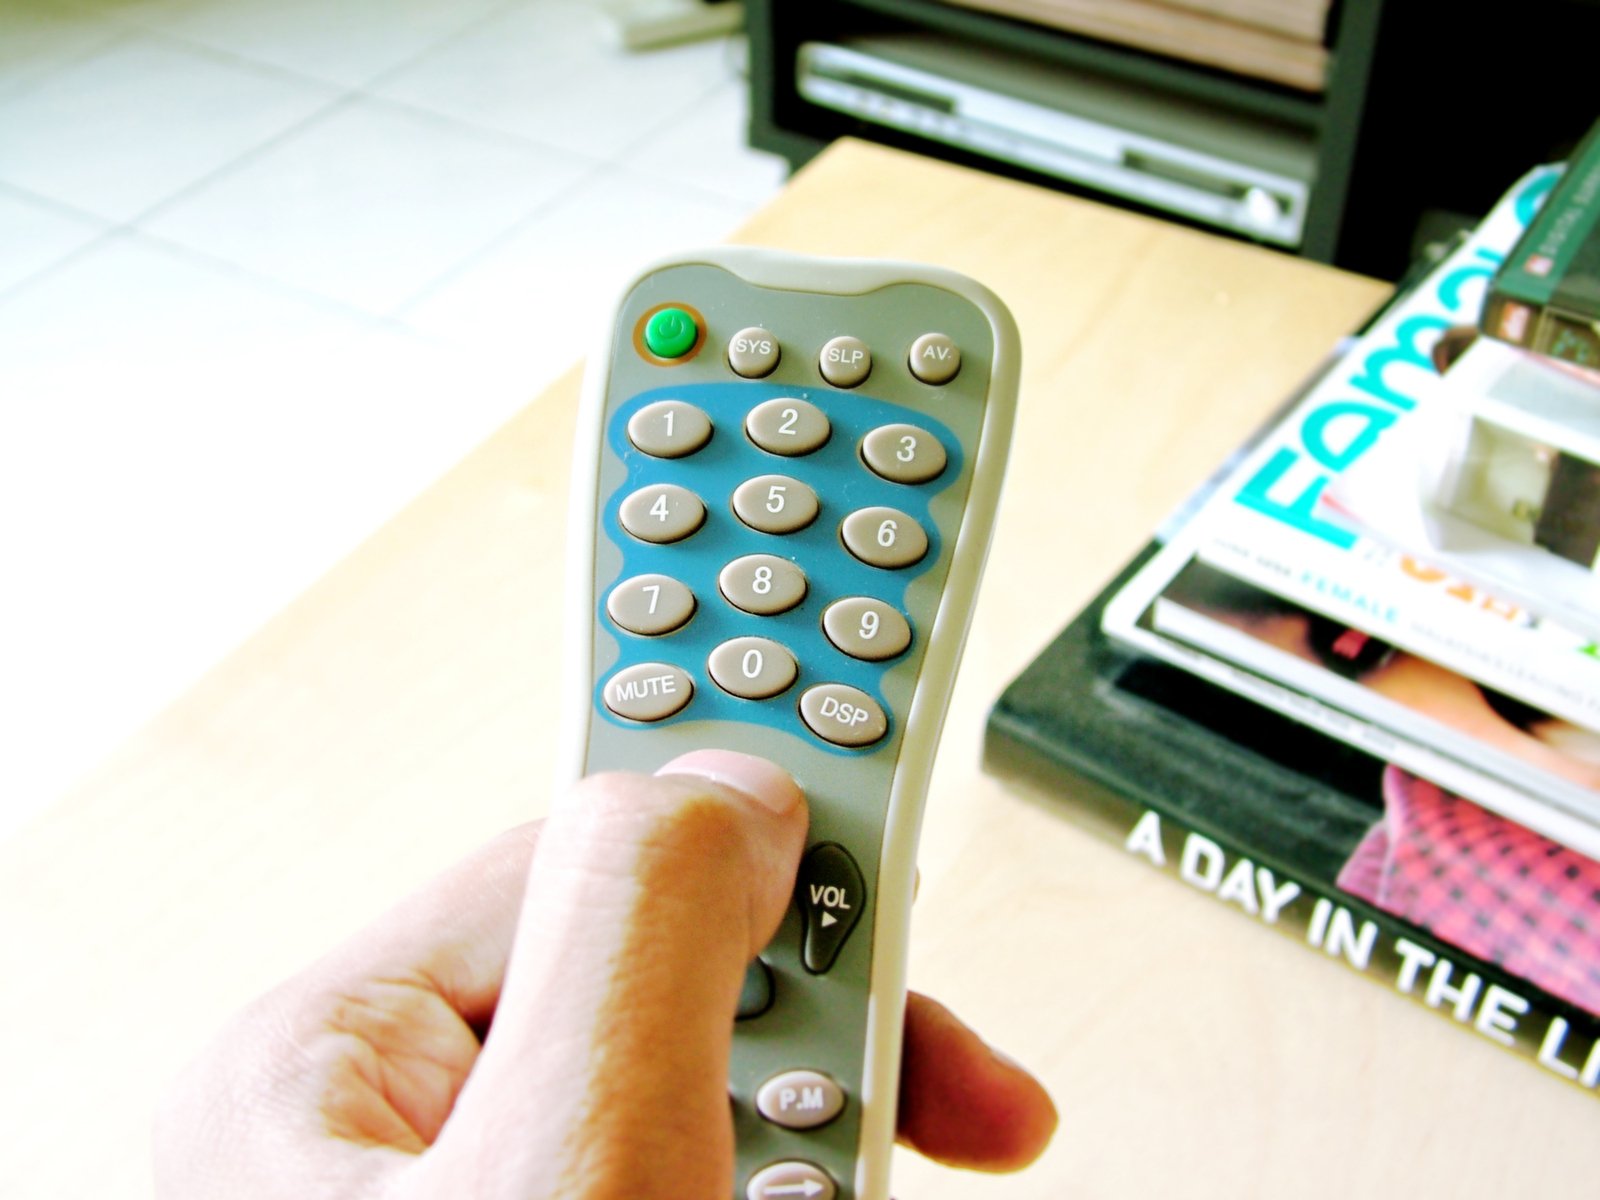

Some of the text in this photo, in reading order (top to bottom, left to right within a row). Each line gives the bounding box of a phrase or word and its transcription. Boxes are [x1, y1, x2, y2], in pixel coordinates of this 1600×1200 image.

[735, 339, 772, 355] SYS
[828, 347, 864, 364] SLP
[663, 410, 675, 437] 1
[778, 408, 799, 435] 2
[896, 435, 917, 462] 3
[649, 494, 669, 522] 4
[766, 485, 787, 513] 5
[877, 519, 898, 547] 6
[752, 566, 773, 594] 8
[642, 585, 661, 615] 7
[1300, 568, 1399, 623] FEMALE
[858, 611, 880, 640] 9
[742, 648, 764, 679] 0
[615, 674, 677, 702] MUTE
[819, 696, 870, 728] DSP
[810, 883, 852, 909] VOL
[1125, 810, 1166, 866] A
[1179, 832, 1301, 924] DAY
[1307, 898, 1379, 971] IN
[1394, 937, 1530, 1046] THE
[779, 1086, 824, 1111] P.M
